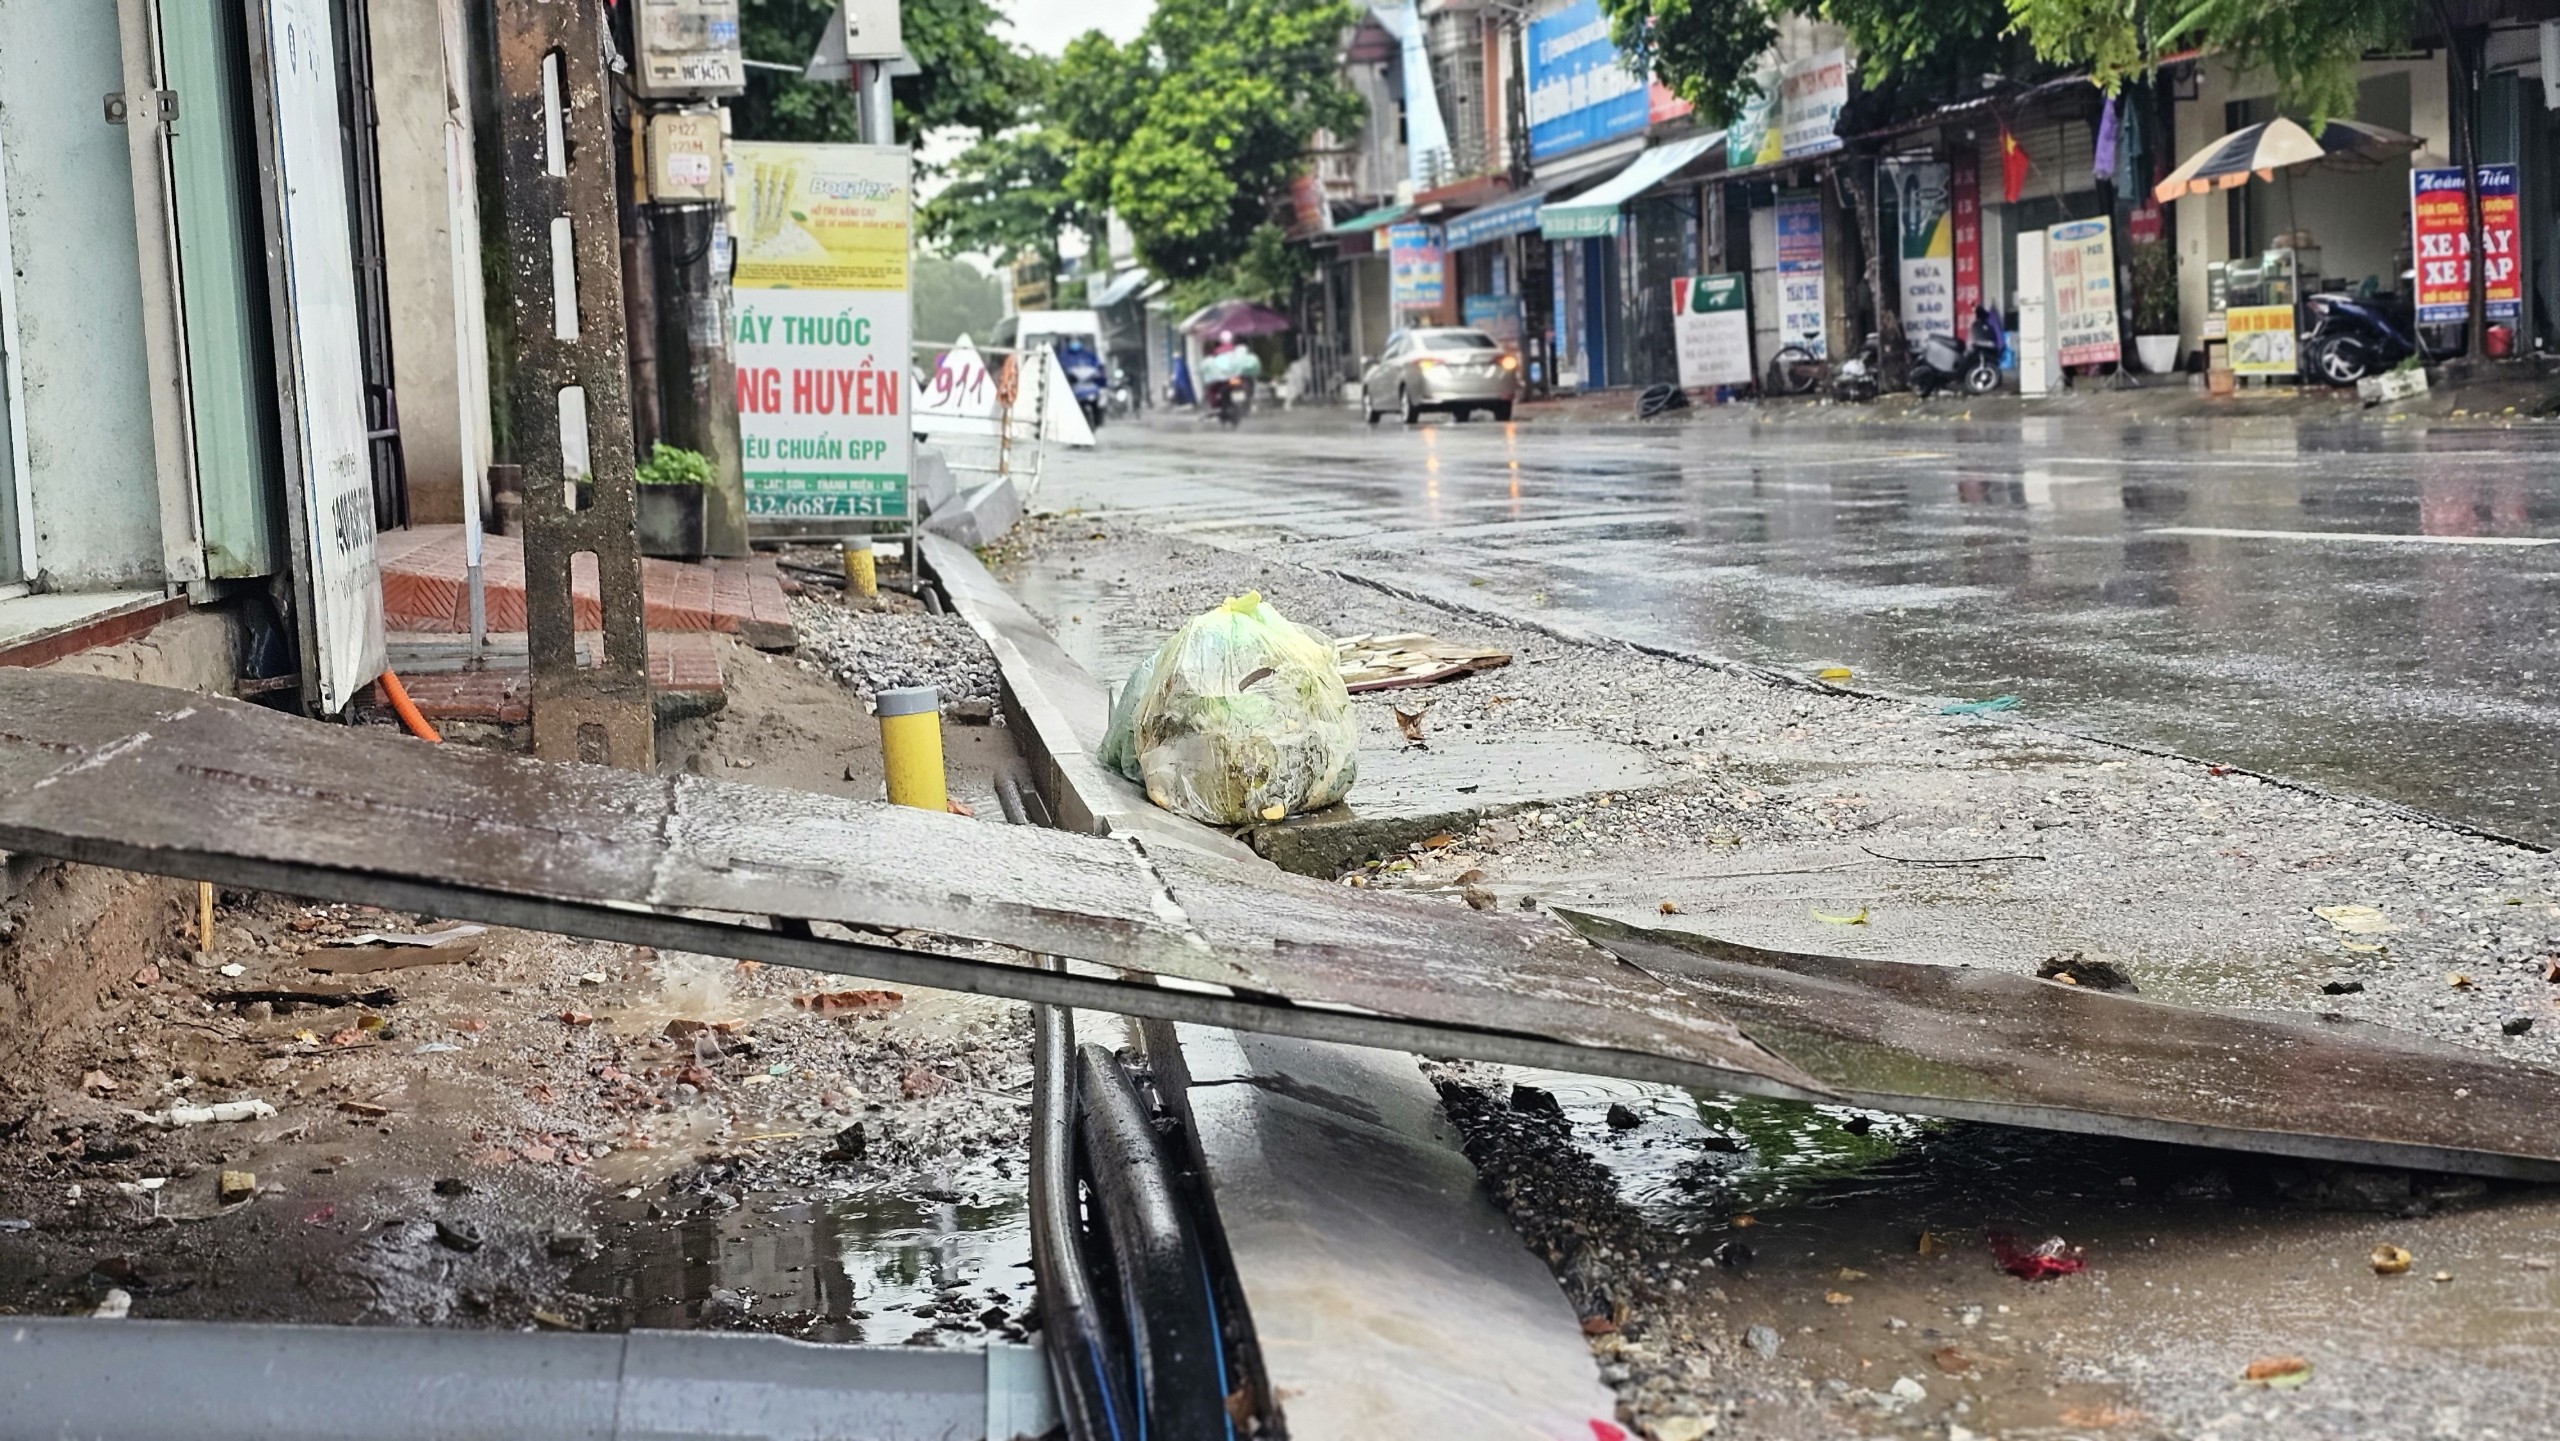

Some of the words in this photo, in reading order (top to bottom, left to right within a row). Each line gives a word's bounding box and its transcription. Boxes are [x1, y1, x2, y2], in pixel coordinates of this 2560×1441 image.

[809, 176, 891, 197] Bocalex
[2418, 173, 2466, 190] Hoàn
[2420, 232, 2453, 257] XE
[2424, 260, 2458, 286] XE
[782, 307, 871, 346] THUỐC
[736, 367, 781, 414] NG
[793, 354, 898, 416] HUYỀN
[931, 363, 985, 408] 911
[776, 431, 842, 460] CHUẨN
[849, 439, 887, 461] GPP
